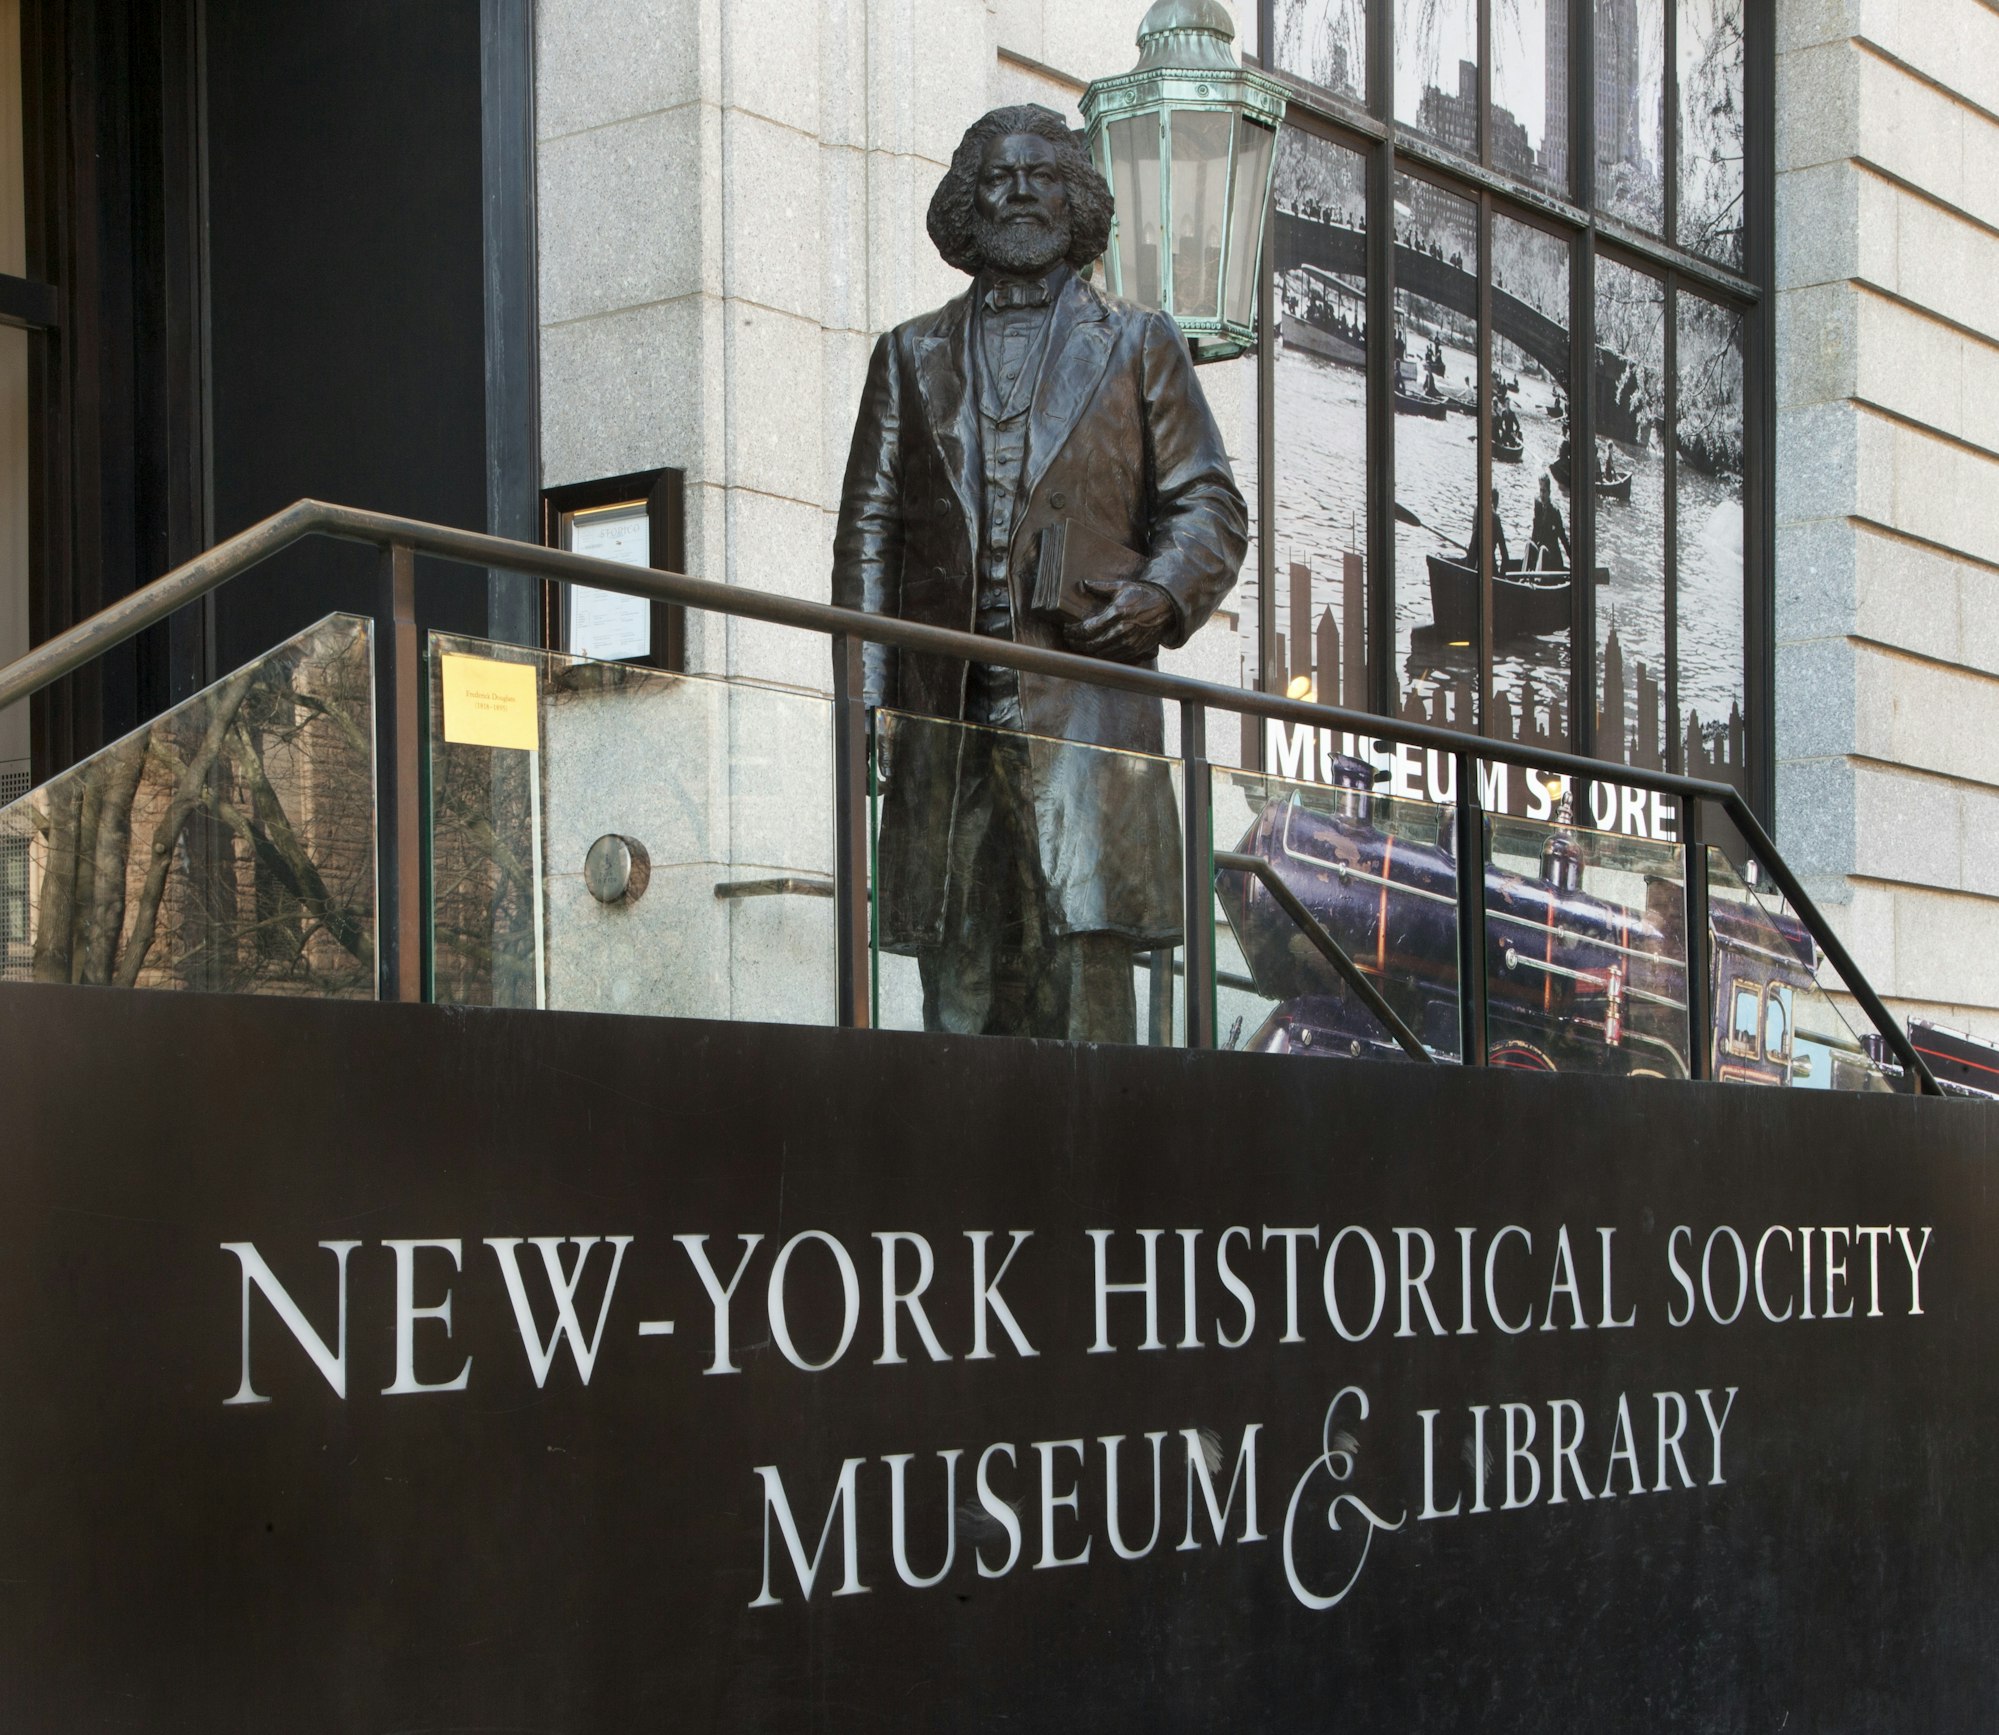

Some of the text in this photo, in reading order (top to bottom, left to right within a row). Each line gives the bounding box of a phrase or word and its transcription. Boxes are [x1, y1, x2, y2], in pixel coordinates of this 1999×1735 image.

[491, 692, 516, 703] Douglass
[1265, 716, 1678, 842] MUSEUM STORE
[220, 1224, 1934, 1405] NEW-YORK HISTORICAL SOCIETY
[747, 1385, 1740, 1611] MUSEUM & LIBRARY
